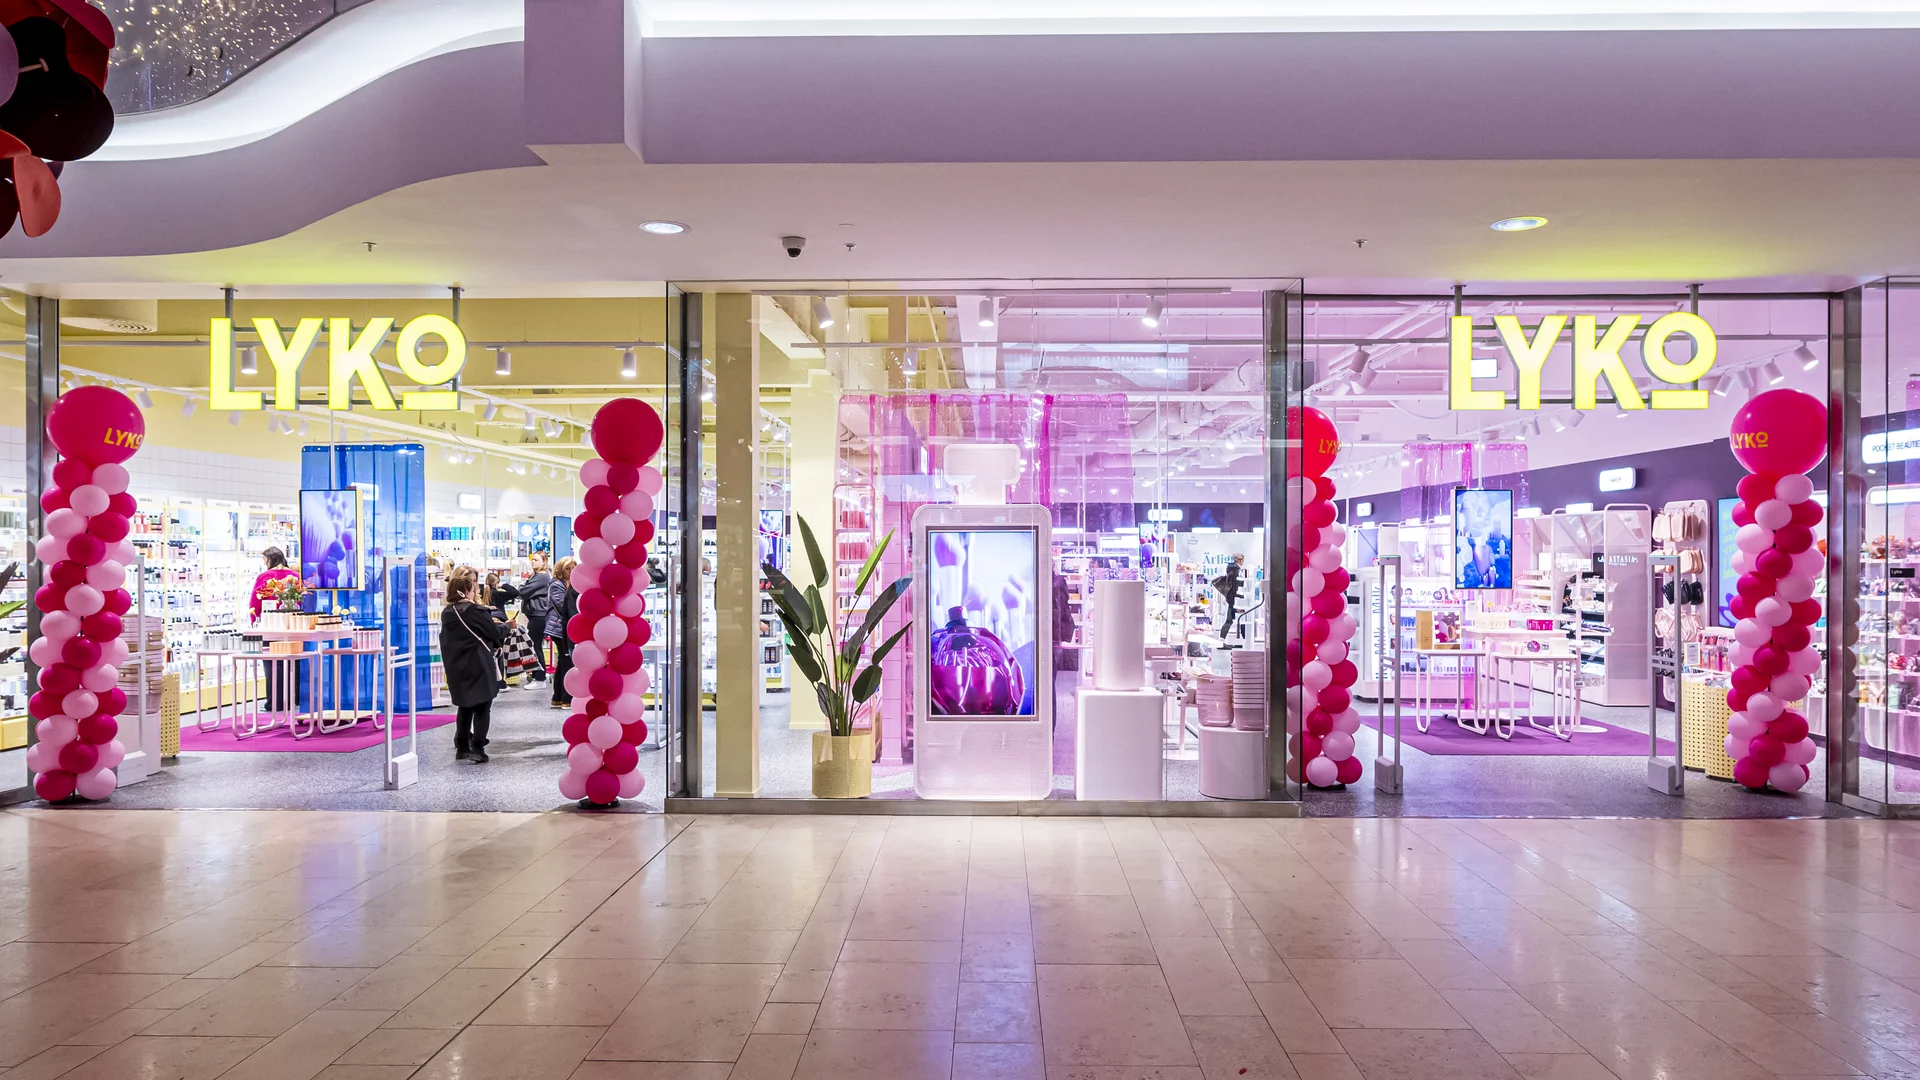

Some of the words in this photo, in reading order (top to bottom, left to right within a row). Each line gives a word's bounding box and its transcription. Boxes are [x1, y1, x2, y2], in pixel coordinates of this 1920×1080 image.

[209, 313, 468, 411] LYKO
[1449, 311, 1718, 411] LYKO
[103, 427, 143, 450] LYKO
[1732, 431, 1769, 449] LYKO
